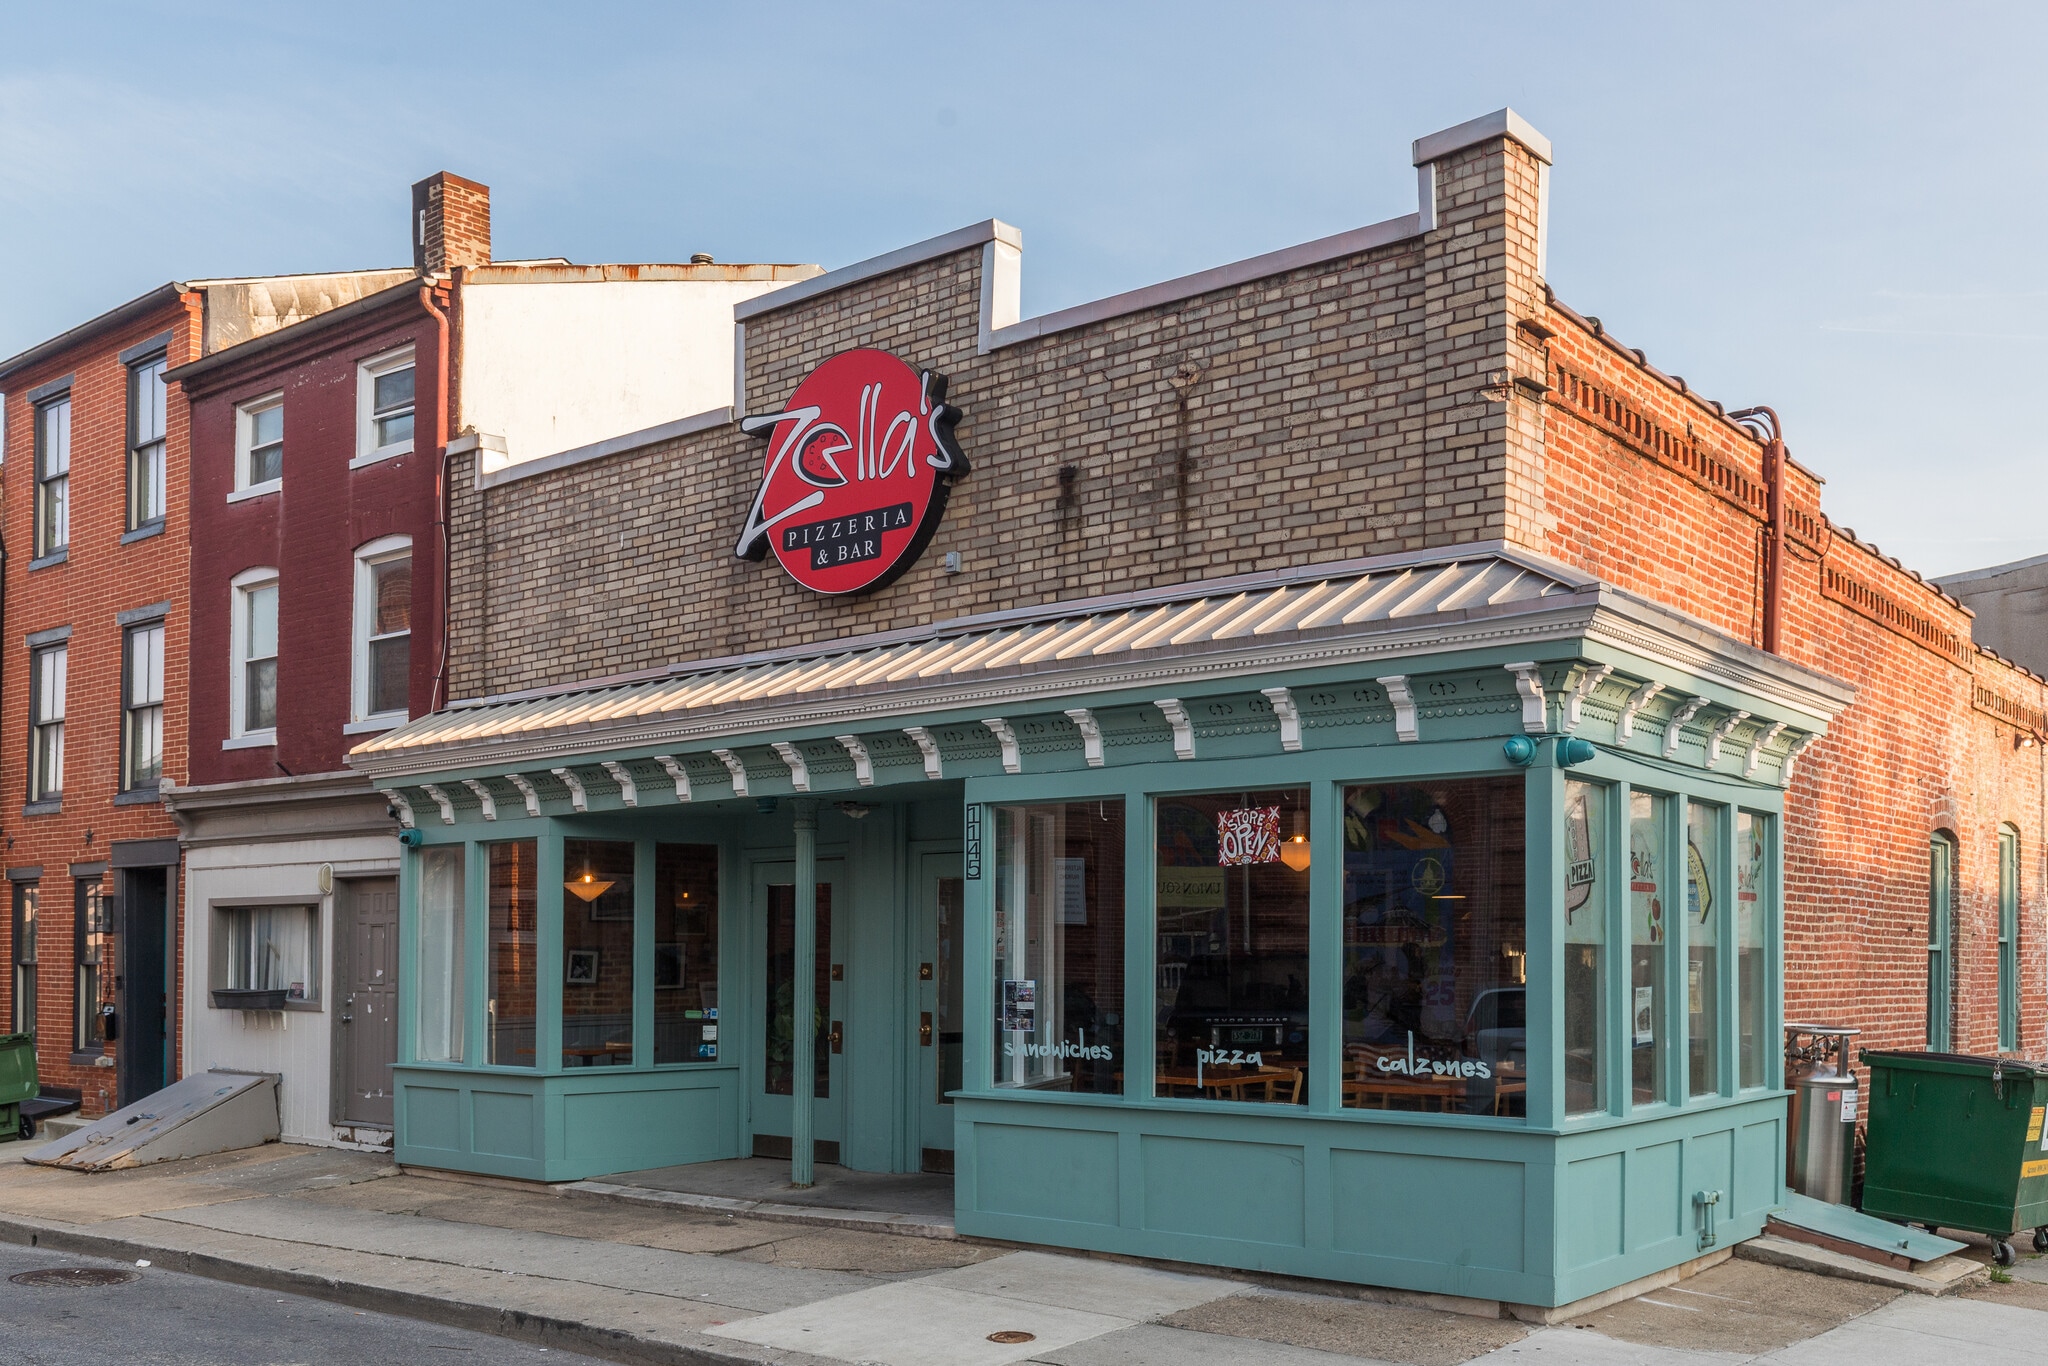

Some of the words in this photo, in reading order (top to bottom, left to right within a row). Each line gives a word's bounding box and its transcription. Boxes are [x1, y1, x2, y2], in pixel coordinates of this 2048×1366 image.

[735, 369, 952, 558] Zella's
[788, 508, 907, 547] PIZZERIA
[817, 549, 829, 565] &
[838, 540, 875, 562] BAR
[1227, 810, 1266, 830] STORE
[967, 804, 981, 880] 1145
[1223, 823, 1270, 858] OPEN
[1571, 861, 1593, 883] PIZZA
[1004, 1020, 1113, 1060] sandwiches
[1376, 1030, 1491, 1079] calzones
[1196, 1044, 1264, 1089] pizza
